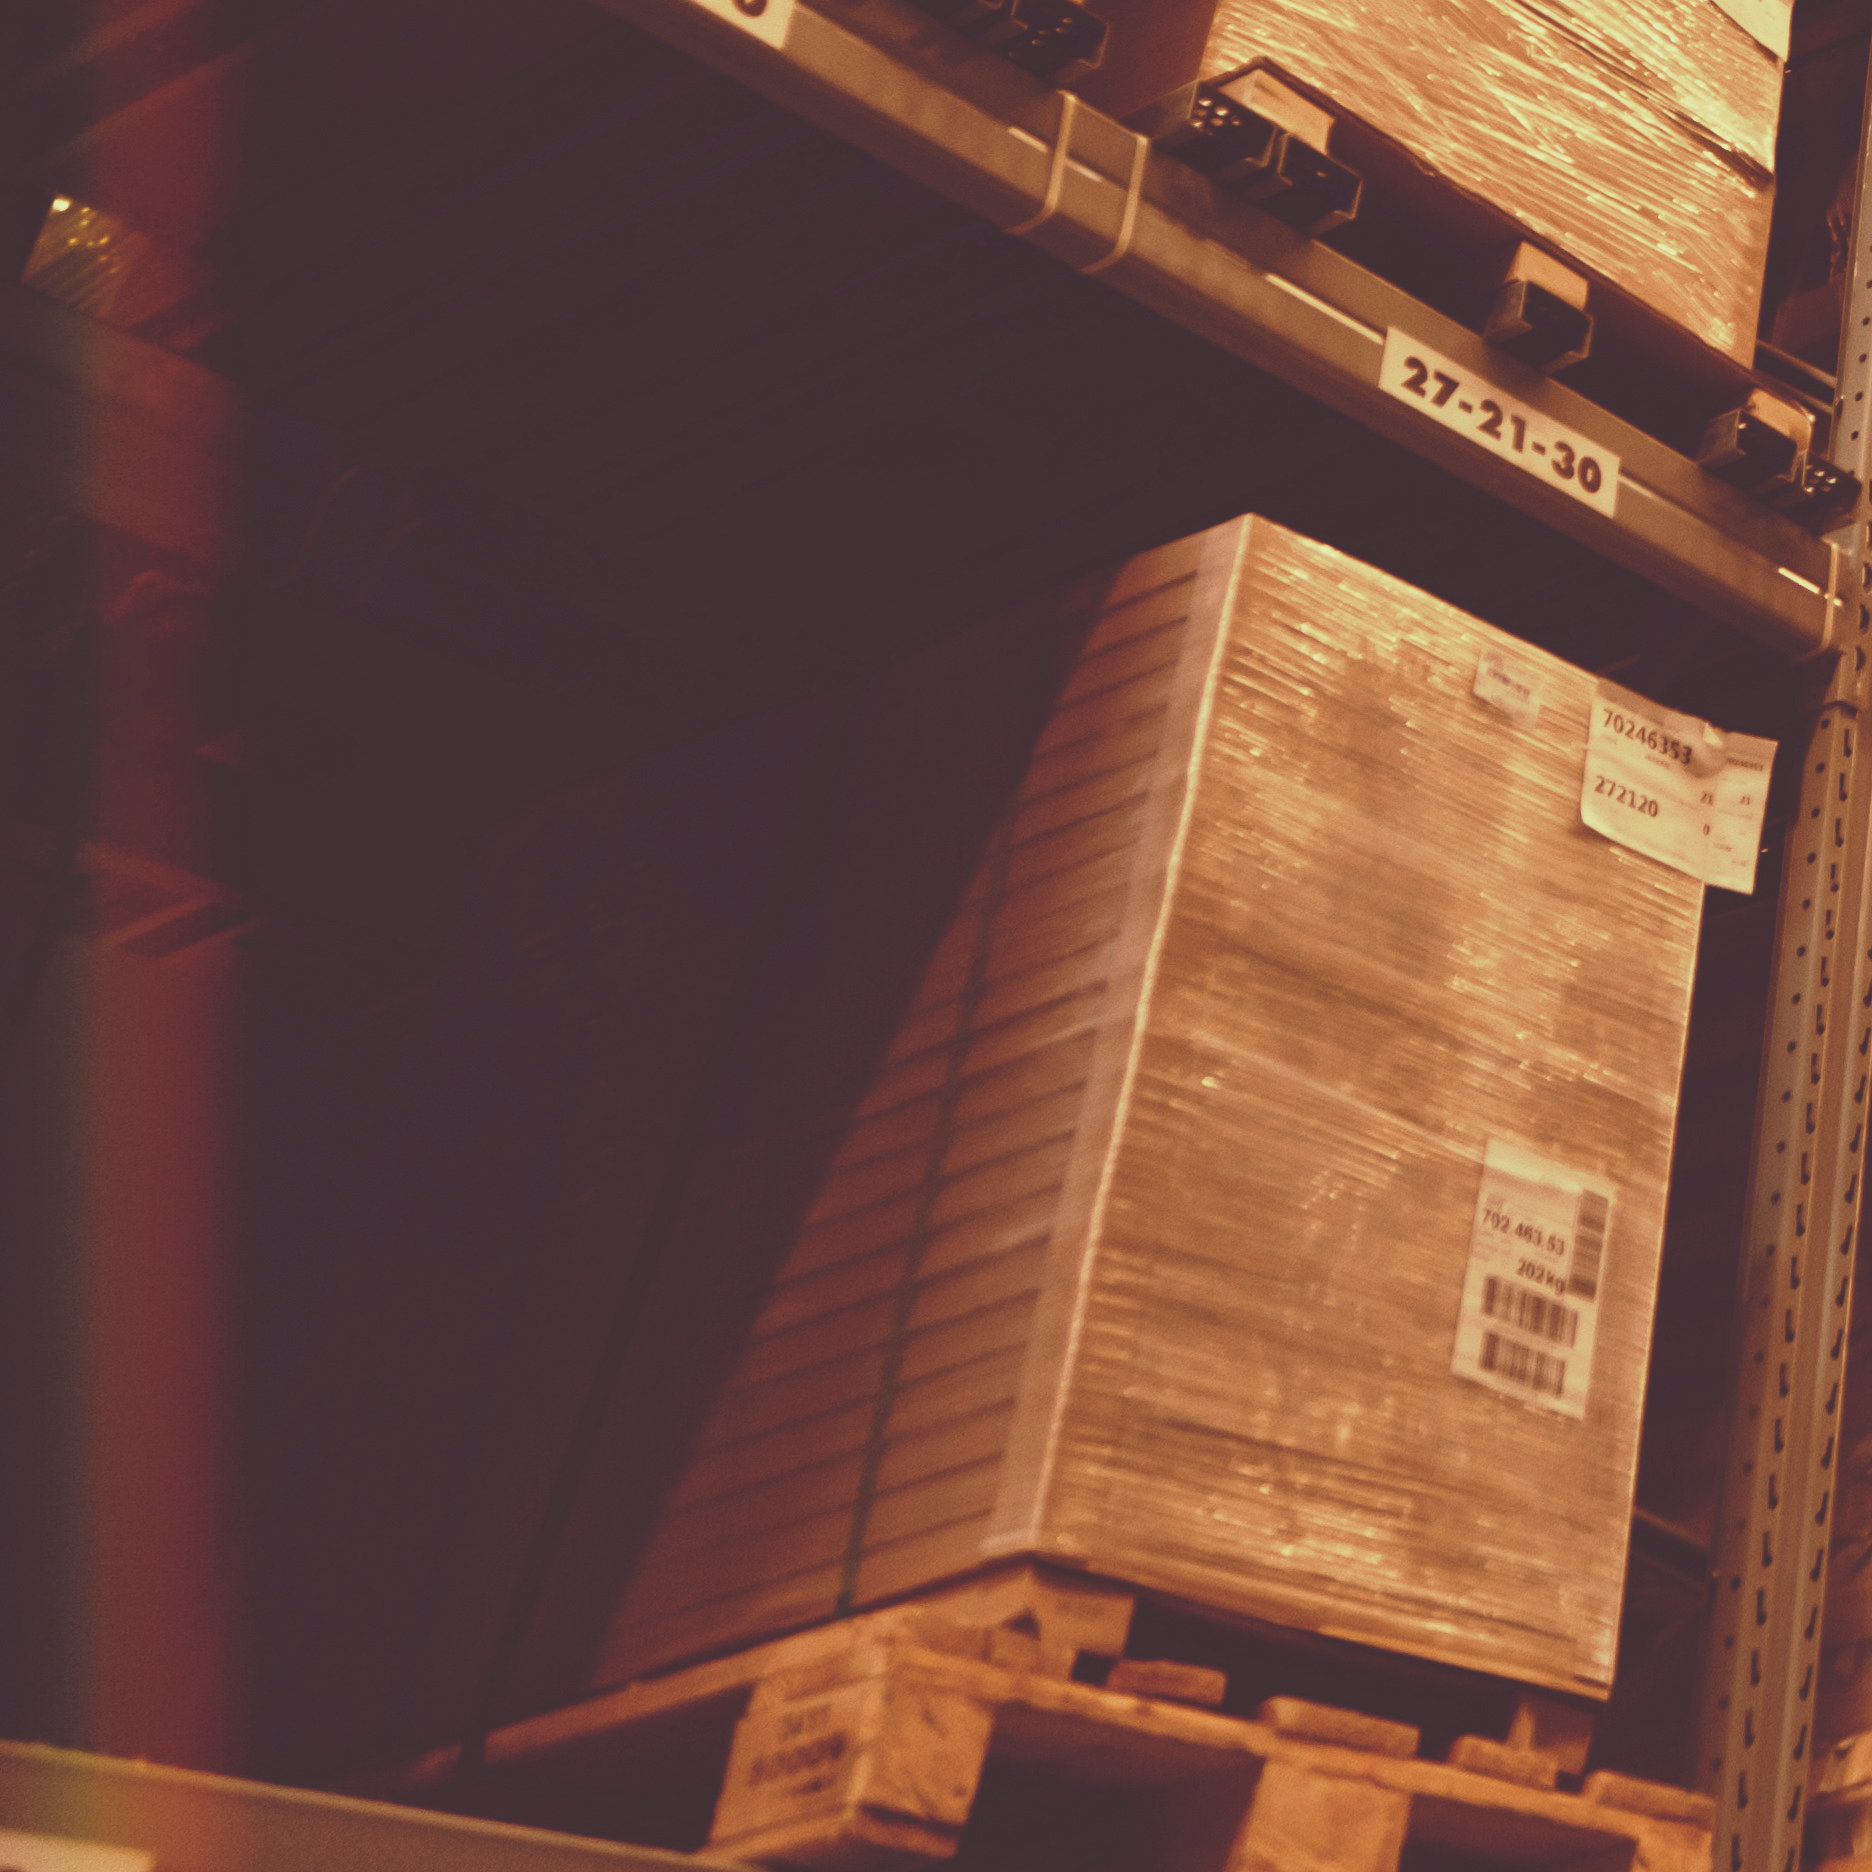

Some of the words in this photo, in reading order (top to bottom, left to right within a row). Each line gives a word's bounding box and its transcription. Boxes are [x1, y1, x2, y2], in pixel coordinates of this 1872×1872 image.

[1401, 355, 1602, 495] 27-21-30
[1603, 707, 1693, 766] 70246353
[1593, 775, 1660, 818] 272120
